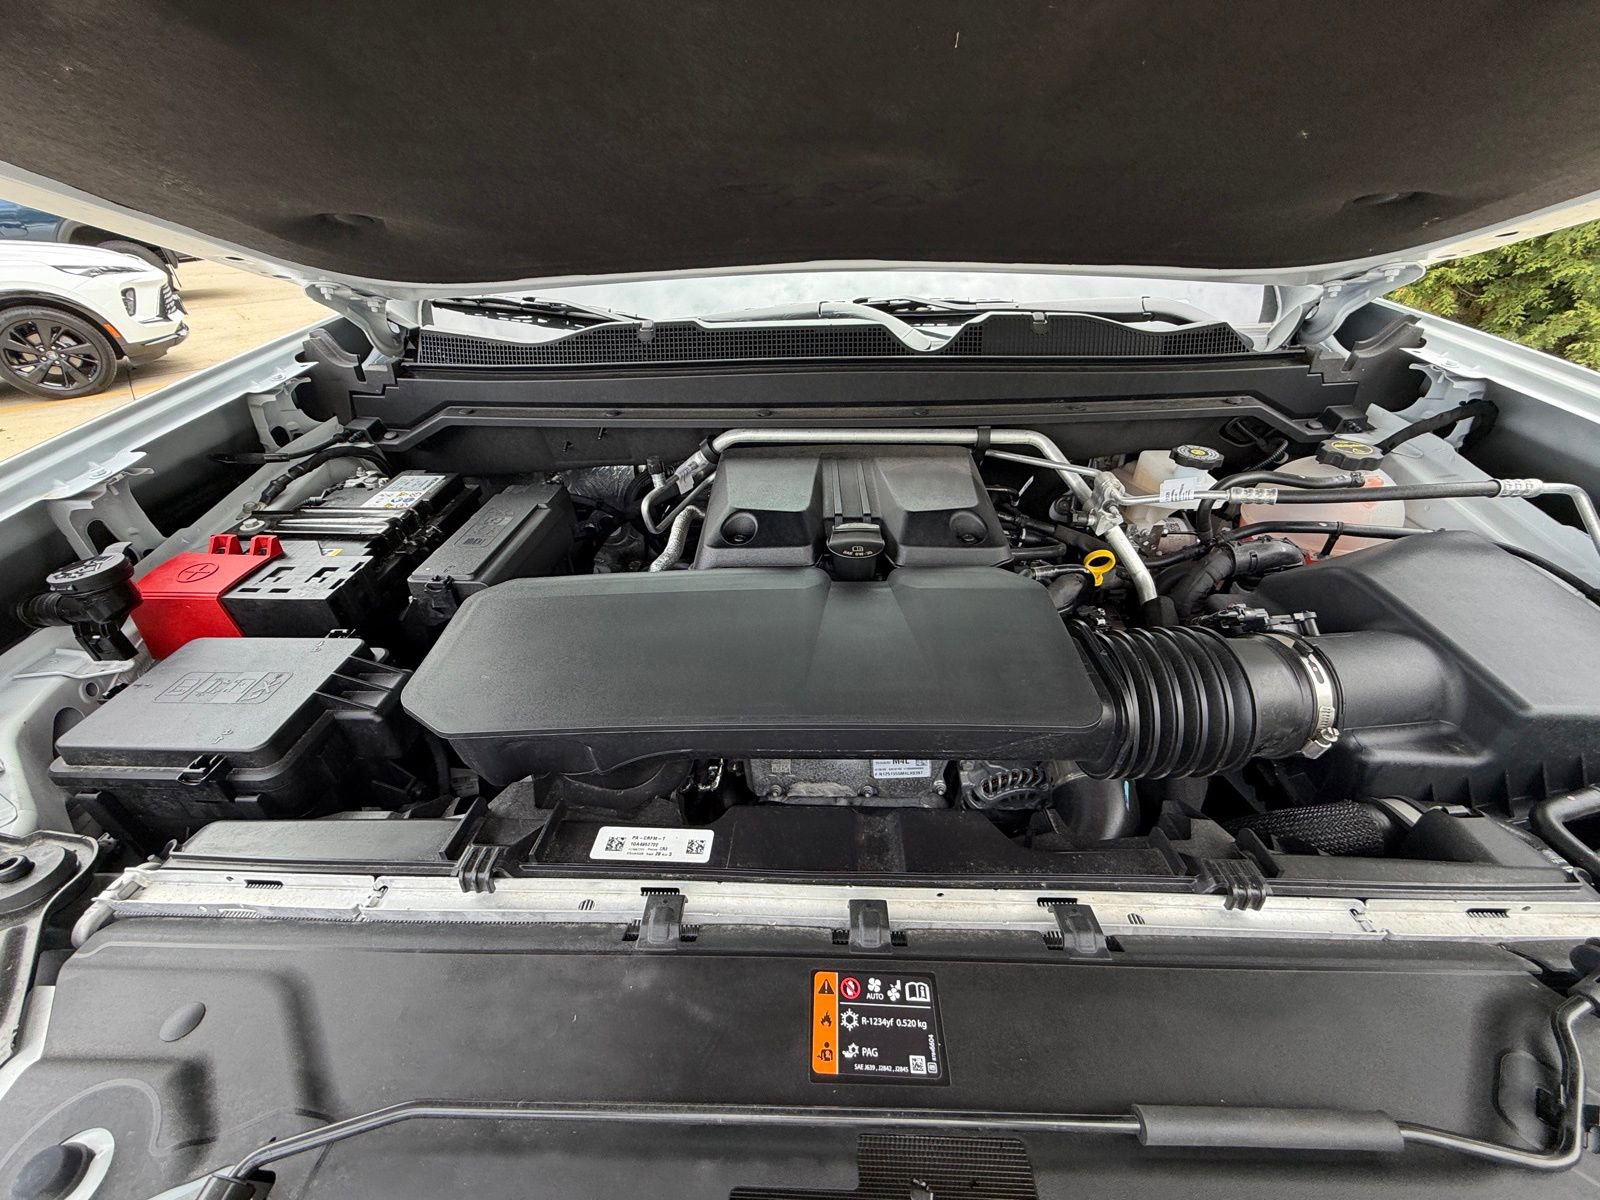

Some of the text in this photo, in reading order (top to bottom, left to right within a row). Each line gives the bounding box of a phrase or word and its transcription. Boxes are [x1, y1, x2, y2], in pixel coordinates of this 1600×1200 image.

[862, 1017, 927, 1030] R-1234yf 0.520 kg
[862, 1047, 878, 1057] PAG
[854, 1063, 864, 1071] SAE
